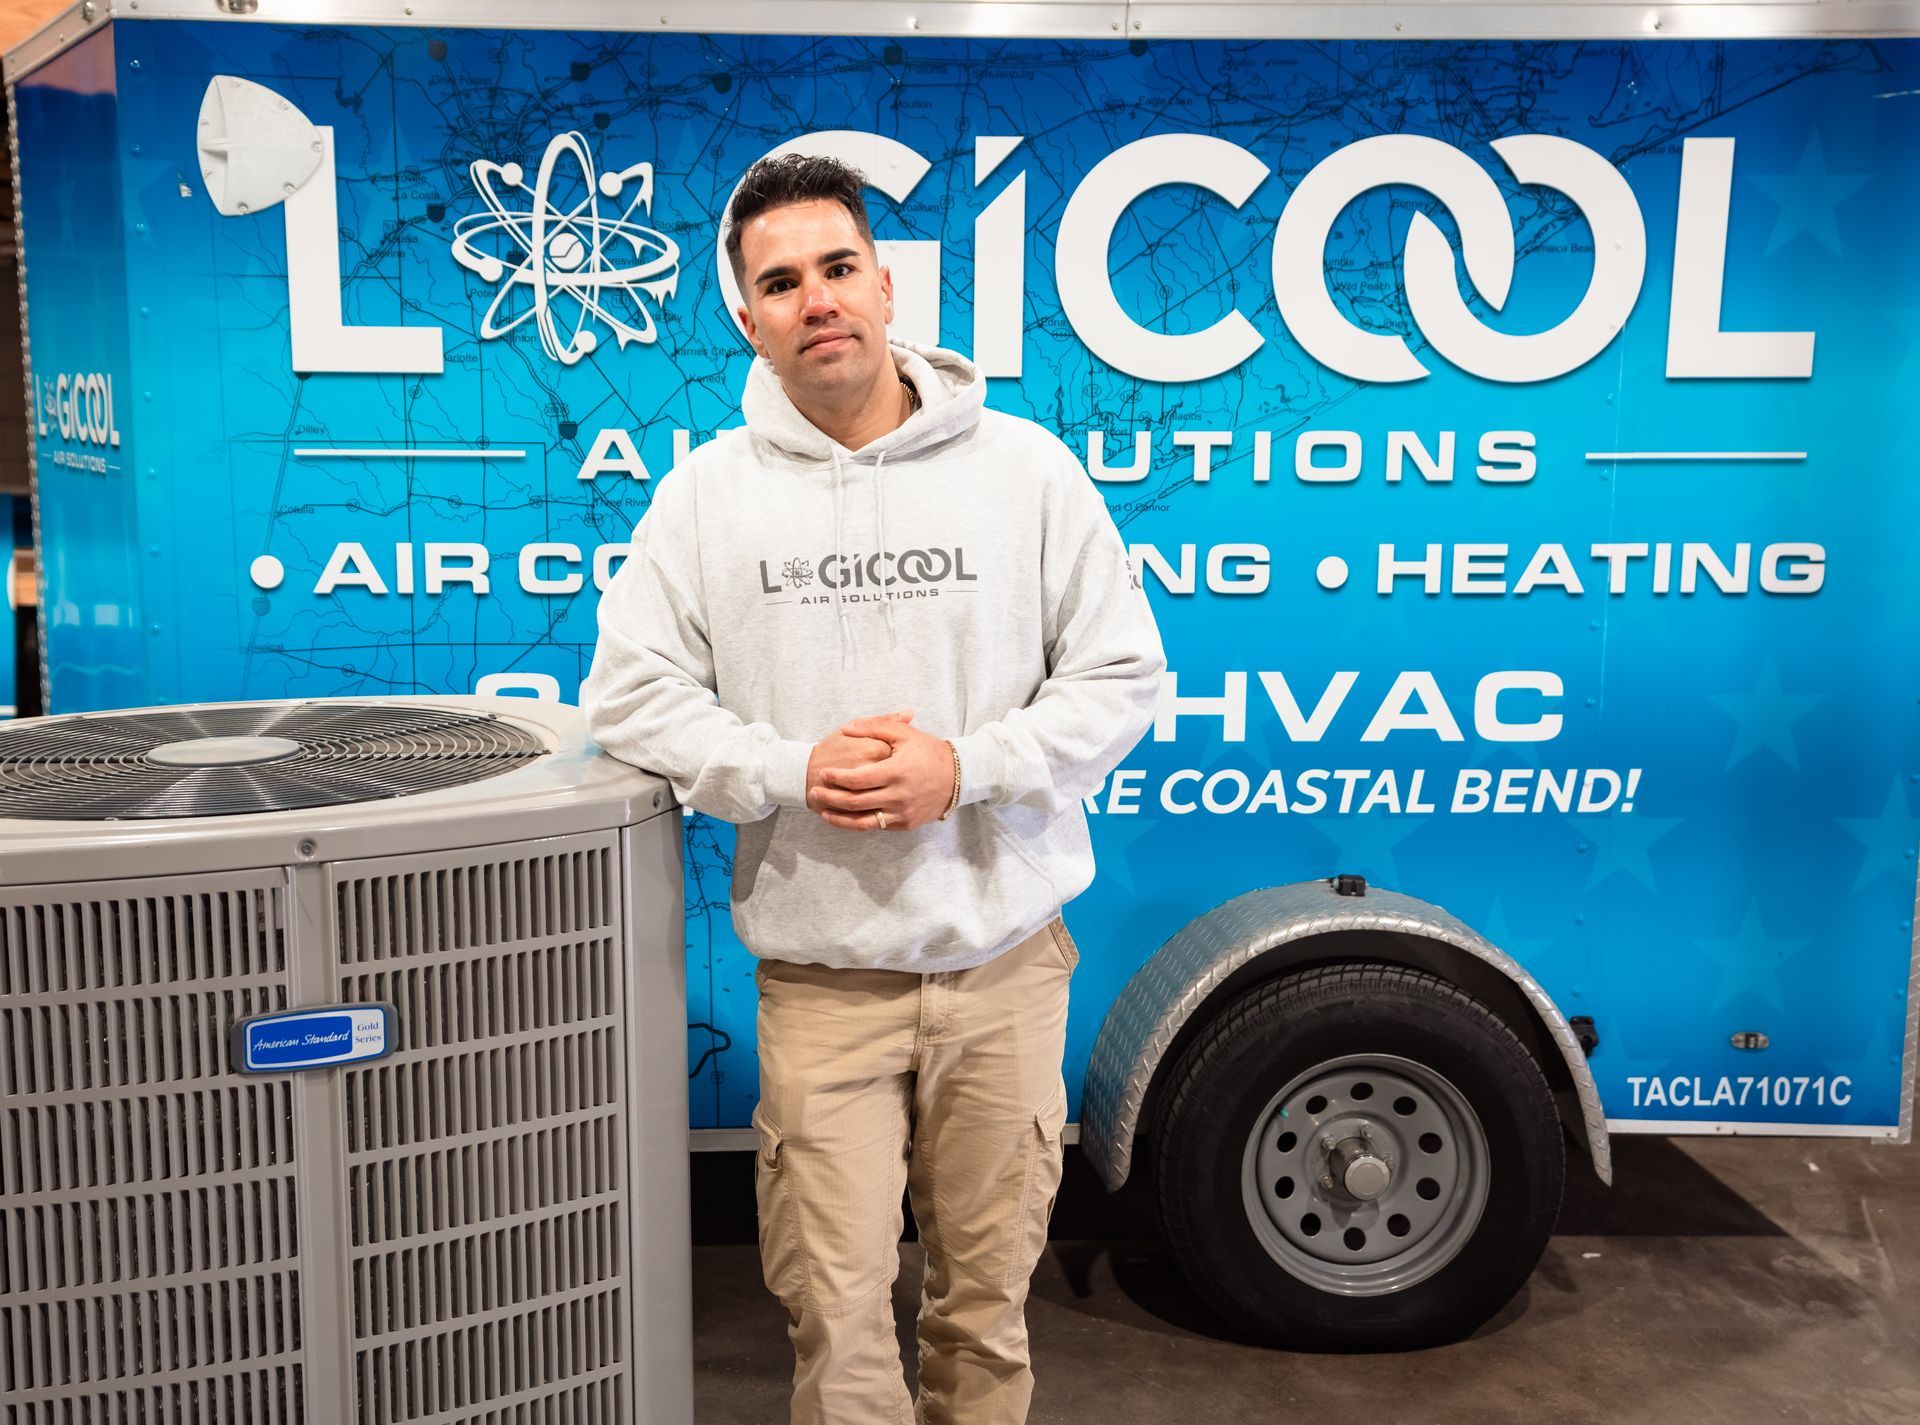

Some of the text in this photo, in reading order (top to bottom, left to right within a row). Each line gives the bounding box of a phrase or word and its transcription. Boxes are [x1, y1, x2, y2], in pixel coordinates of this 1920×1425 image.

[297, 423, 326, 436] Dilley
[280, 504, 316, 515] Cotulla
[313, 542, 490, 594] AIR
[1377, 542, 1826, 594] HEATING
[800, 588, 940, 605] AIR SOLUTIONS
[1153, 670, 1565, 743] HVAC
[1158, 768, 1437, 815] COASTAL
[1450, 768, 1643, 815] BEND!
[357, 1021, 379, 1032] Gold
[252, 1029, 350, 1052] American Standard
[354, 1033, 382, 1045] Series
[1626, 1075, 1852, 1107] TACLA71071C
